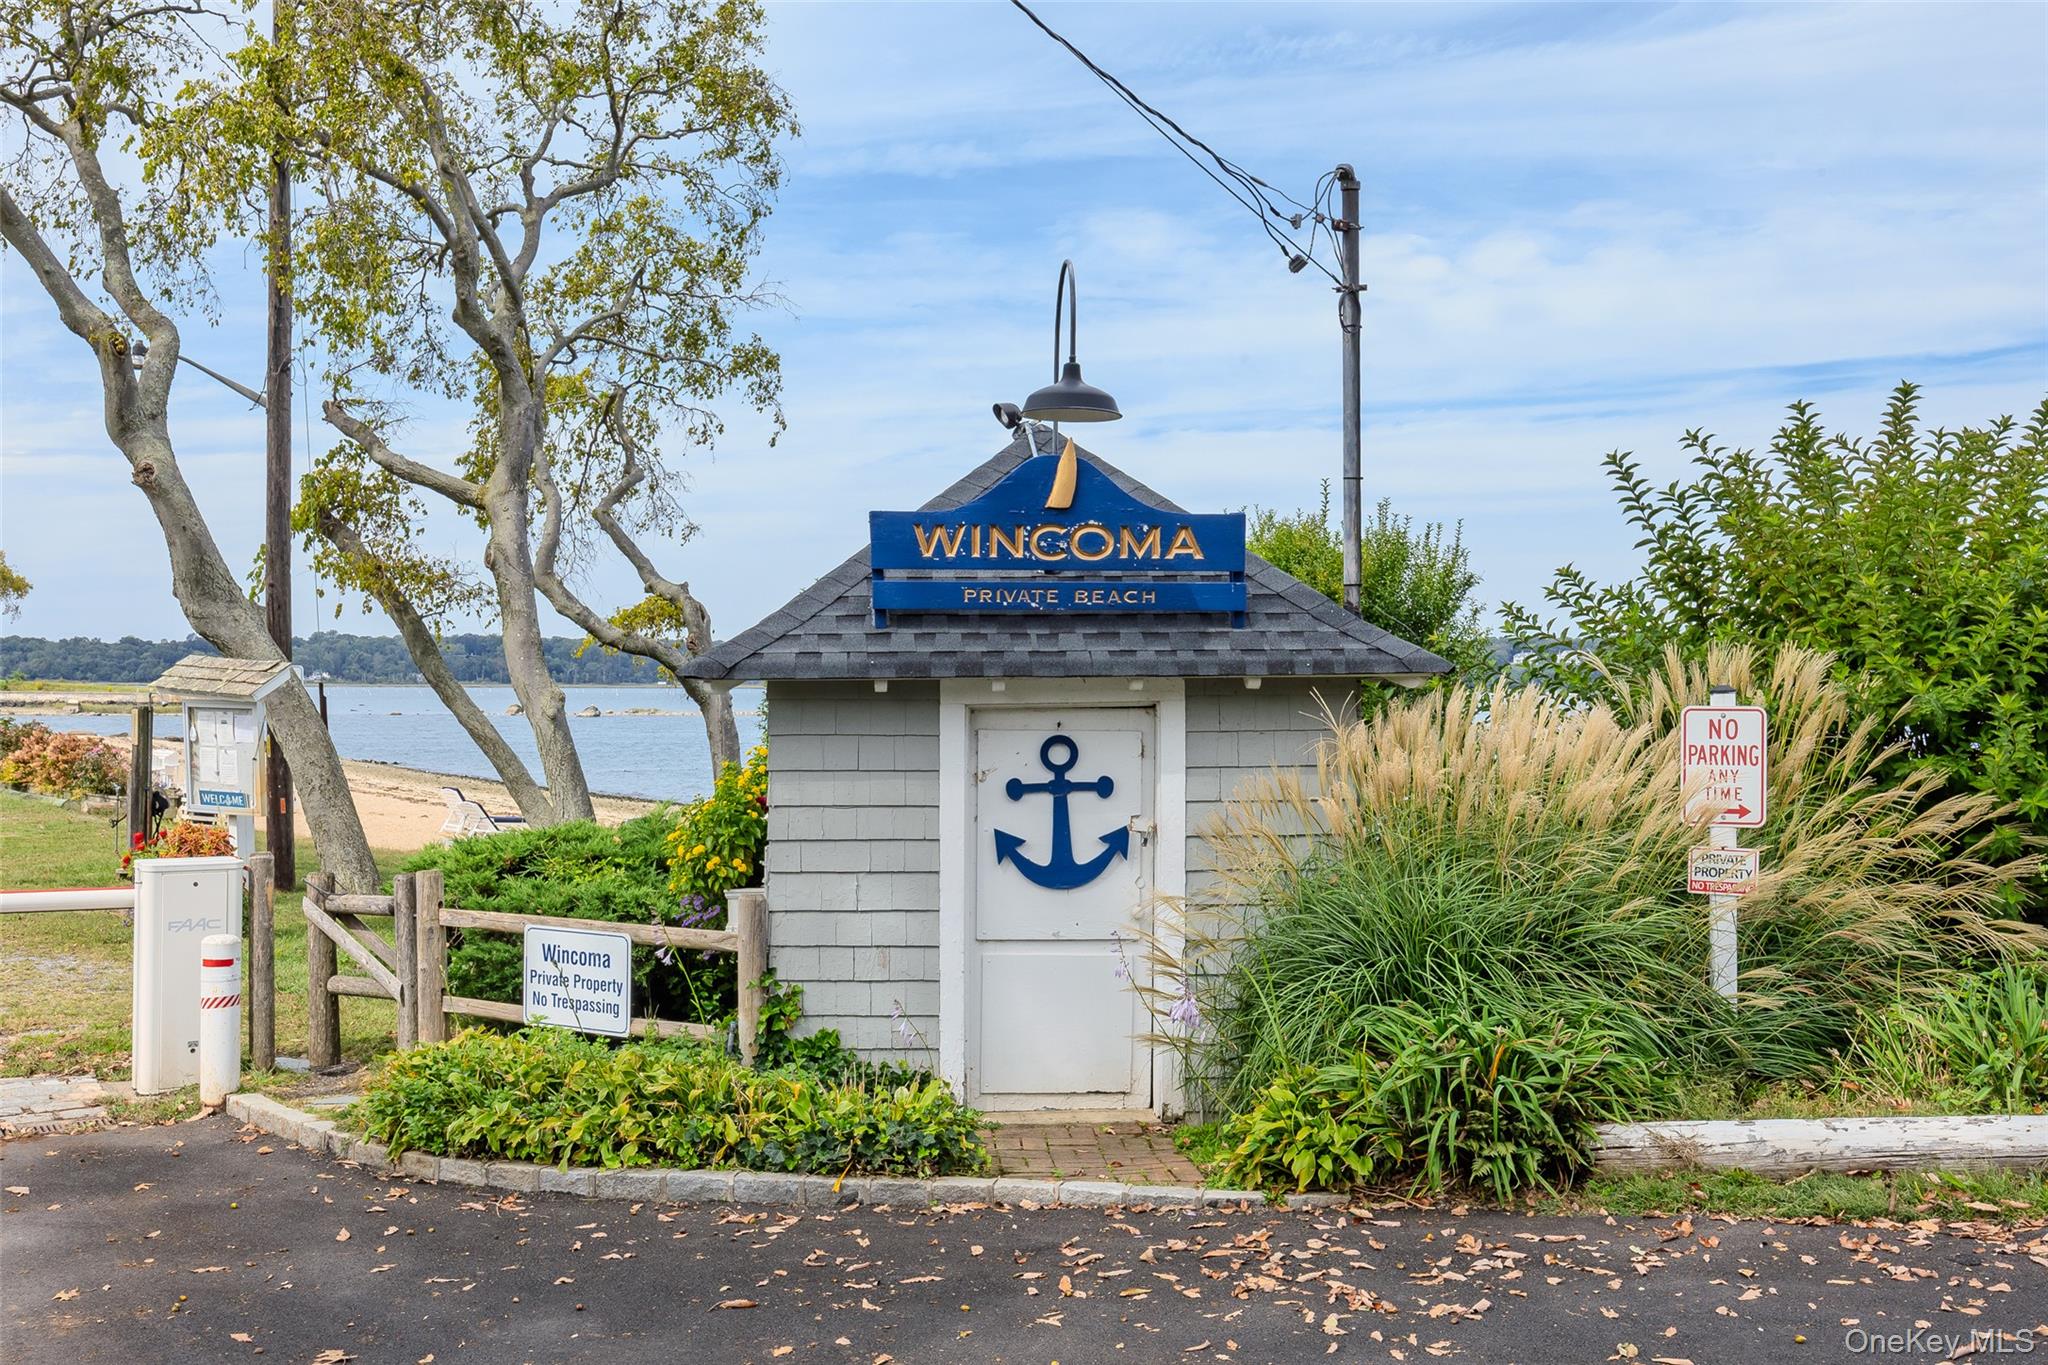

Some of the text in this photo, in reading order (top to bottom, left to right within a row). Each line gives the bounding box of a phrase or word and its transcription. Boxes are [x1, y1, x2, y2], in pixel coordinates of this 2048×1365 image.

[912, 523, 1204, 561] WINCOMA
[963, 588, 1156, 604] PRIVATE BEACH
[1708, 718, 1739, 740] NO
[1688, 744, 1759, 766] PARKING
[1709, 769, 1740, 783] ANY
[1705, 786, 1743, 801] TIME
[1701, 853, 1747, 866] PRIVATE
[1691, 881, 1704, 890] NO
[168, 918, 221, 932] FAAC
[541, 943, 611, 968] Wincoma
[530, 969, 624, 997] Private Property
[532, 991, 620, 1018] No Trespassing
